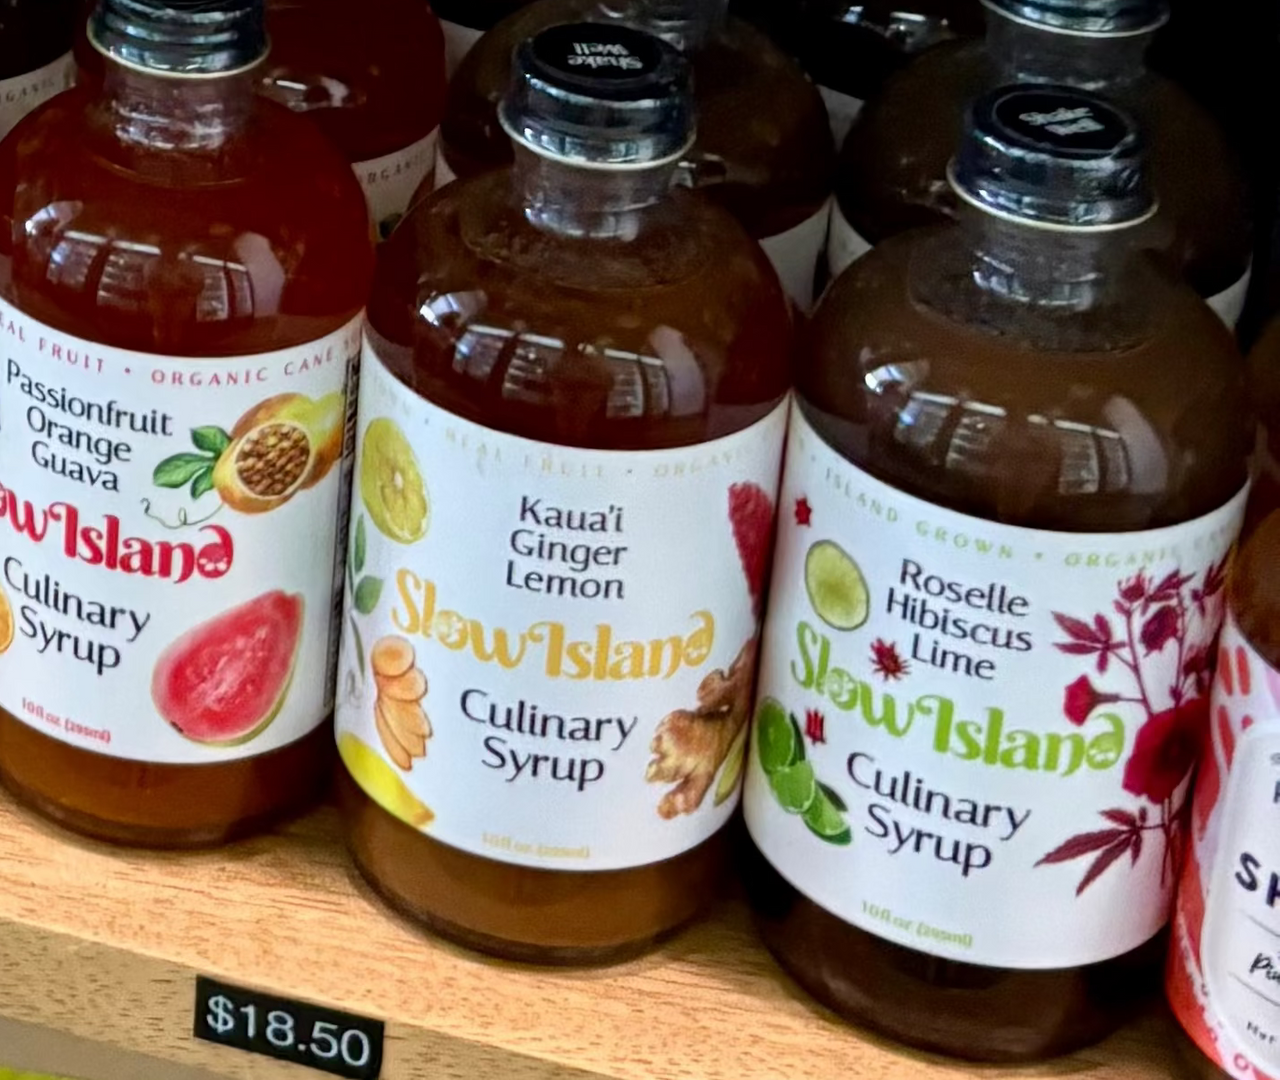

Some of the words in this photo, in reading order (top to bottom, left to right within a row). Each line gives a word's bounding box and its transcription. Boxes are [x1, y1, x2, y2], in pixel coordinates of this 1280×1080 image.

[38, 336, 105, 373] FRUIT
[151, 367, 269, 386] ORGANIC
[284, 349, 334, 376] CANE
[6, 357, 174, 437] Passionfruit
[26, 404, 133, 464] Orange
[31, 441, 120, 493] Guava
[519, 495, 624, 535] Kaua'i
[824, 466, 899, 525] ISLAND
[915, 519, 1014, 560] GROWN
[505, 560, 625, 599] Lemon
[510, 529, 628, 573] Ginger
[2, 555, 152, 642] Culinary
[900, 557, 1031, 618] Roselle
[18, 605, 122, 676] Syrup
[886, 588, 1035, 653] Hibiscus
[911, 634, 997, 681] Lime
[459, 688, 638, 752] Culinary
[482, 736, 605, 791] Syrup
[845, 750, 1032, 842] Culinary
[864, 804, 993, 878] Syrup
[206, 995, 371, 1068] $18.50
